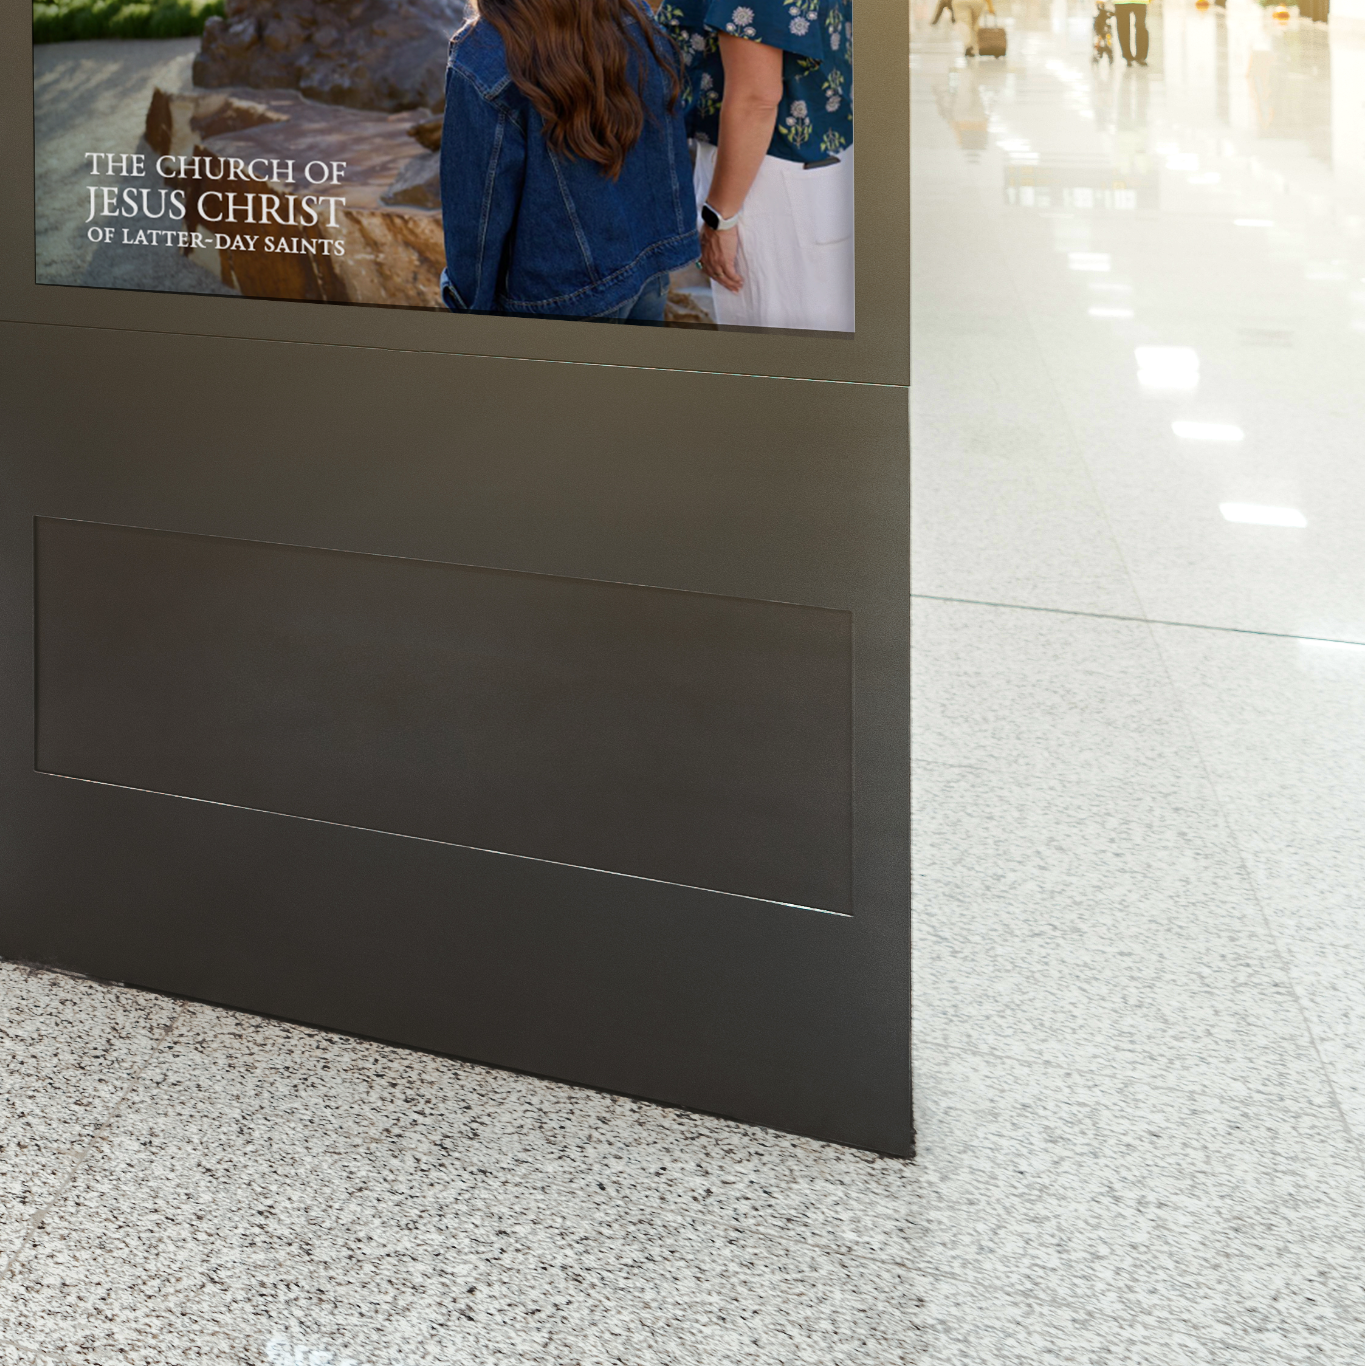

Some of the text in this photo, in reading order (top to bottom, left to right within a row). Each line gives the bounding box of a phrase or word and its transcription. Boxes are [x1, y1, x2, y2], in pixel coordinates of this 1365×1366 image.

[84, 152, 347, 185] THE CHURCH OF
[85, 185, 346, 228] JESUS CHRIST
[87, 226, 345, 256] OF LATTER-DAY SAINTS
